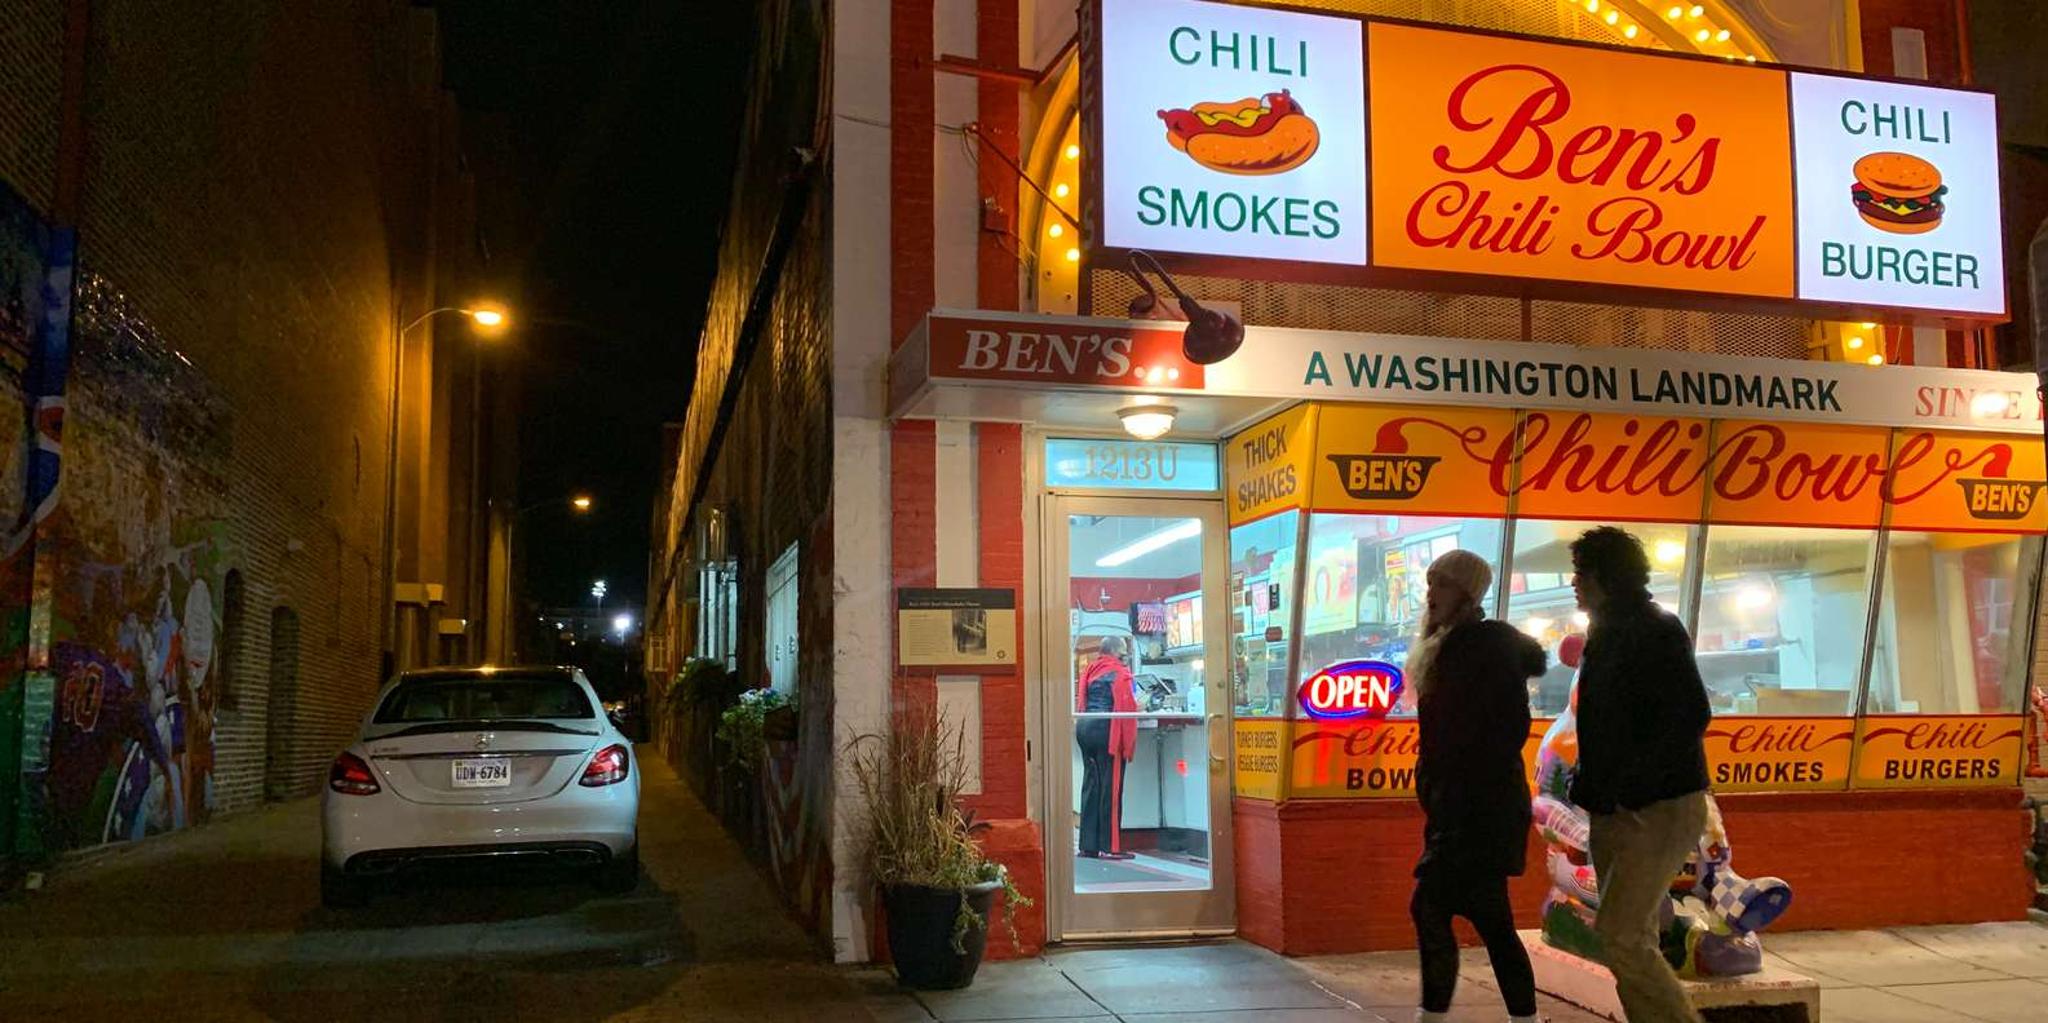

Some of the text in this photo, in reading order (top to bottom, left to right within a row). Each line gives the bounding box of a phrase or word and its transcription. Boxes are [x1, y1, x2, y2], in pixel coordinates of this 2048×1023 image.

[1168, 26, 1308, 77] CHILI
[1433, 63, 1721, 196] Ben's
[1841, 99, 1951, 144] CHILI
[1137, 185, 1341, 240] SMOKES
[1405, 180, 1767, 271] Chili Bowl
[1822, 241, 1980, 289] BURGER
[1303, 350, 1333, 386] A
[1344, 352, 1618, 400] WASHINGTON
[1630, 368, 1842, 412] LANDMARK
[1243, 424, 1289, 471] THICK
[1489, 412, 1936, 505] Chili Bowl
[1238, 463, 1297, 513] SHAKES
[1348, 459, 1422, 492] BEN'S
[1971, 483, 2033, 514] BEN'S
[1310, 674, 1391, 709] OPEN
[1343, 726, 1420, 757] Chi
[1729, 724, 1822, 753] Chili
[1904, 722, 1990, 750] Chili
[1346, 767, 1414, 791] BOW
[1716, 762, 1824, 784] SMOKES
[1885, 758, 2000, 780] BURGERS
